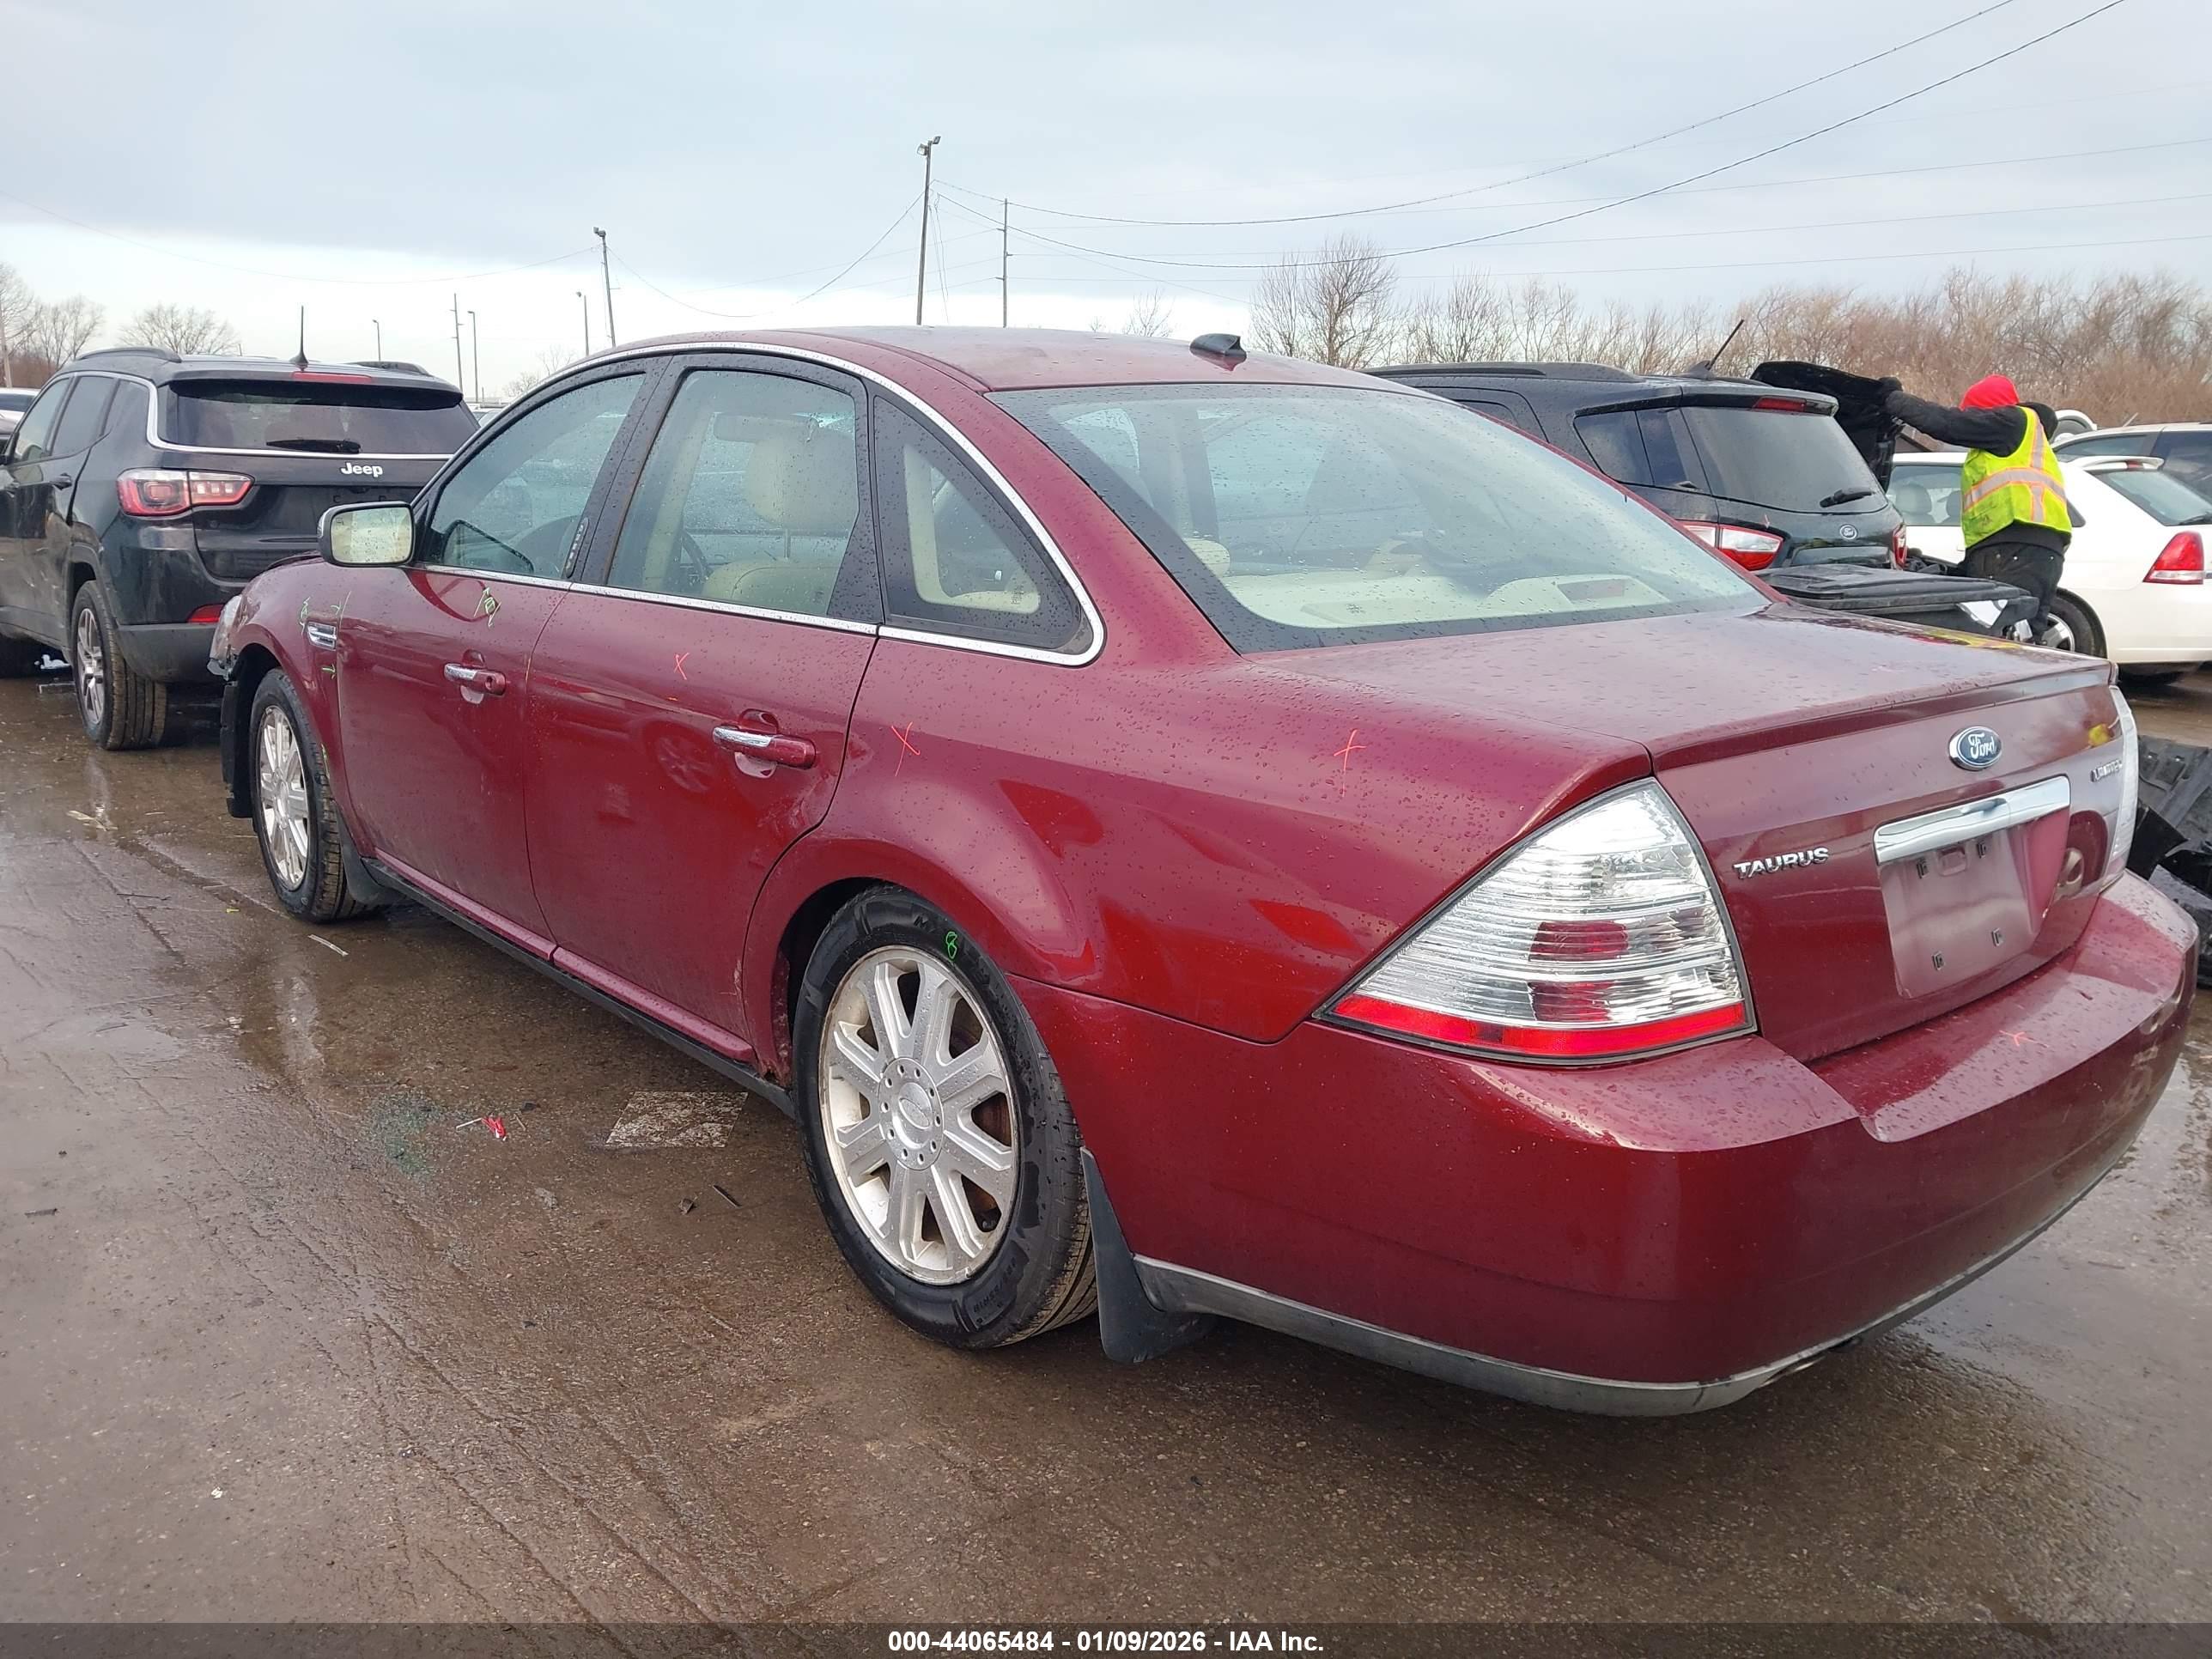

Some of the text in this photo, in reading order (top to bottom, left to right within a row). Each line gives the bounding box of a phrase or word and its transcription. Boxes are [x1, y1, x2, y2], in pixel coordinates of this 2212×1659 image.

[340, 462, 383, 477] Jeep
[1968, 732, 1996, 759] Ford
[1733, 846, 1829, 879] TAURUS
